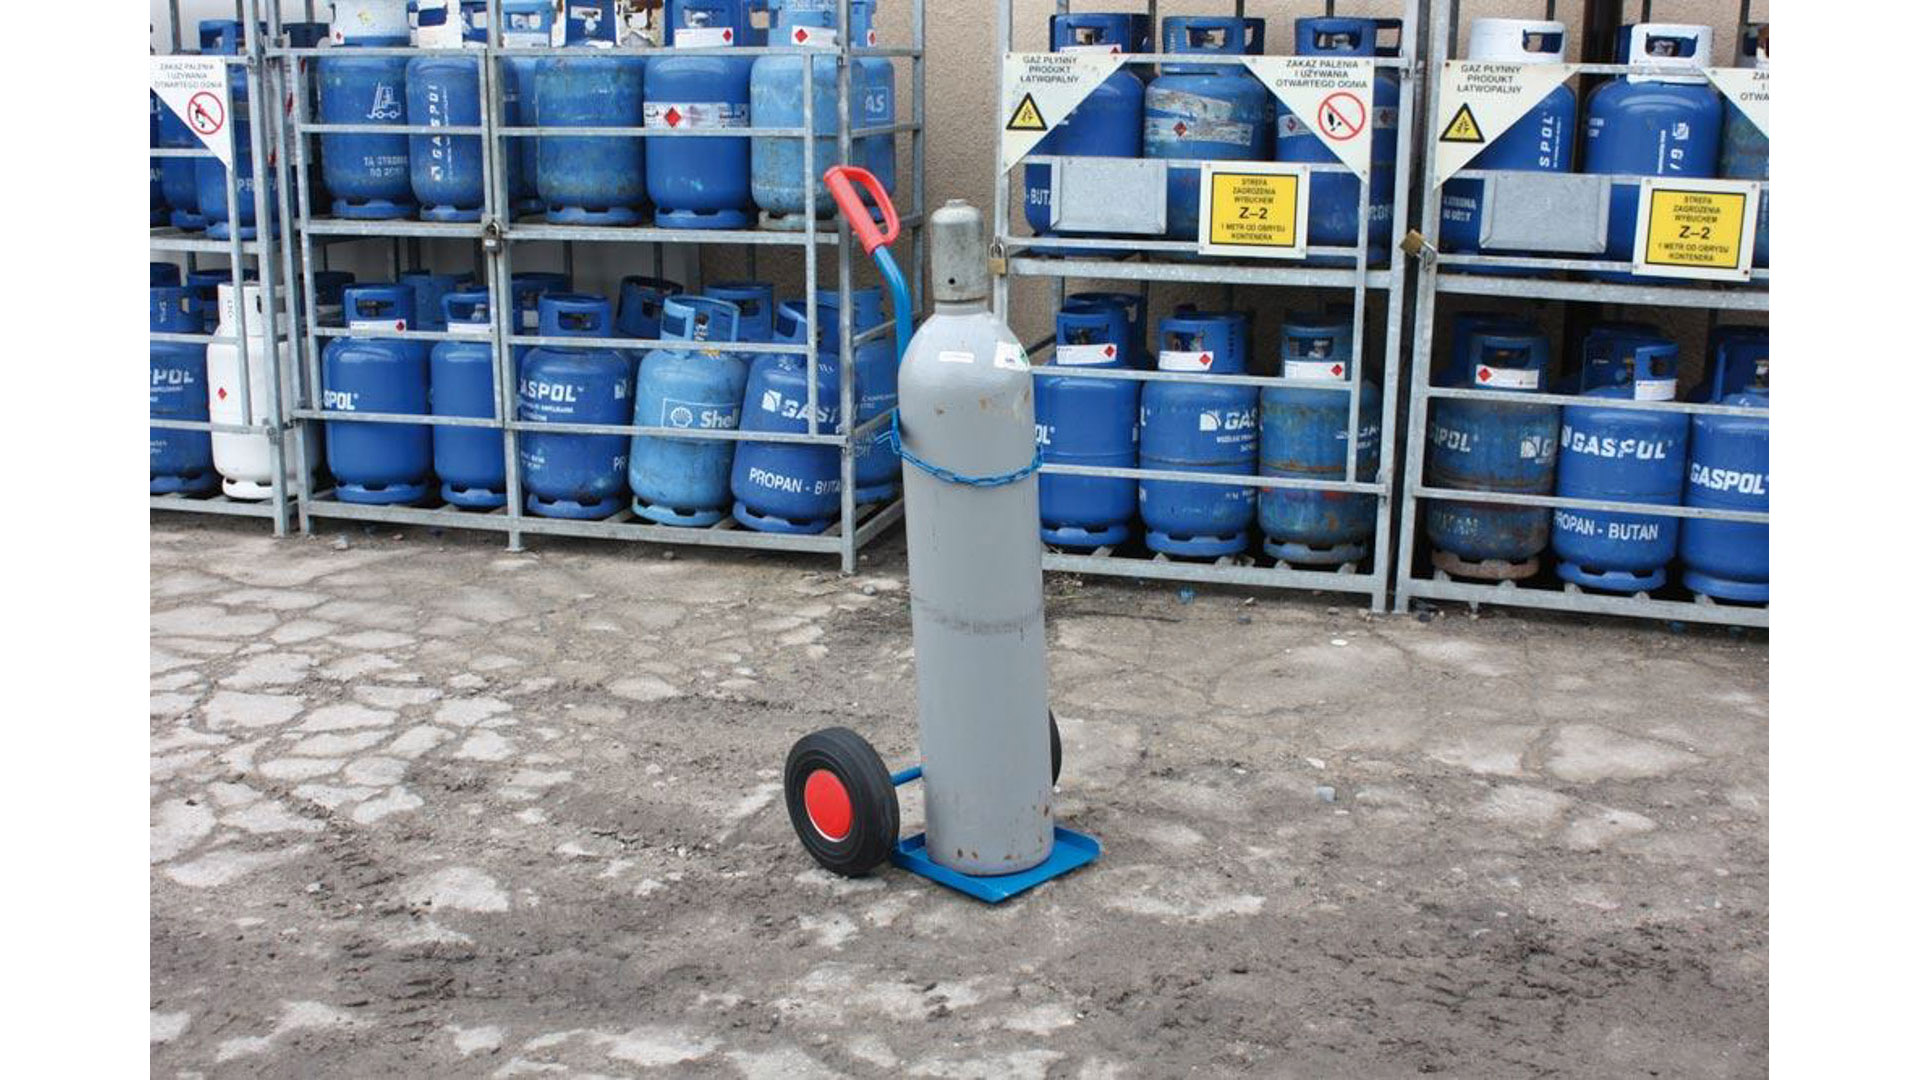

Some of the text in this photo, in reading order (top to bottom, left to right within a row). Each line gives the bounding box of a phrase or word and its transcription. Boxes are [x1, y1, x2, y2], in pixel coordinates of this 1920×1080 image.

[1023, 56, 1040, 64] GAZ
[1286, 59, 1358, 69] ZAKAZ PALENIA
[1028, 65, 1071, 74] PRODUKT
[1461, 64, 1481, 73] GAZ
[1467, 74, 1513, 83] PRODUKT
[1275, 79, 1368, 89] OTWARTEGO OGNIA
[1240, 178, 1268, 186] STREFA
[1031, 187, 1052, 206] BUT
[1683, 196, 1713, 204] STREFA
[1226, 223, 1246, 231] METR
[150, 367, 195, 386] POL
[1433, 425, 1472, 454] POL
[1571, 431, 1668, 460] GASPOL
[748, 468, 803, 495] PROPAN
[814, 479, 843, 496] BUTA
[1690, 462, 1766, 495] GASPOL
[1607, 521, 1660, 542] BUTAN
